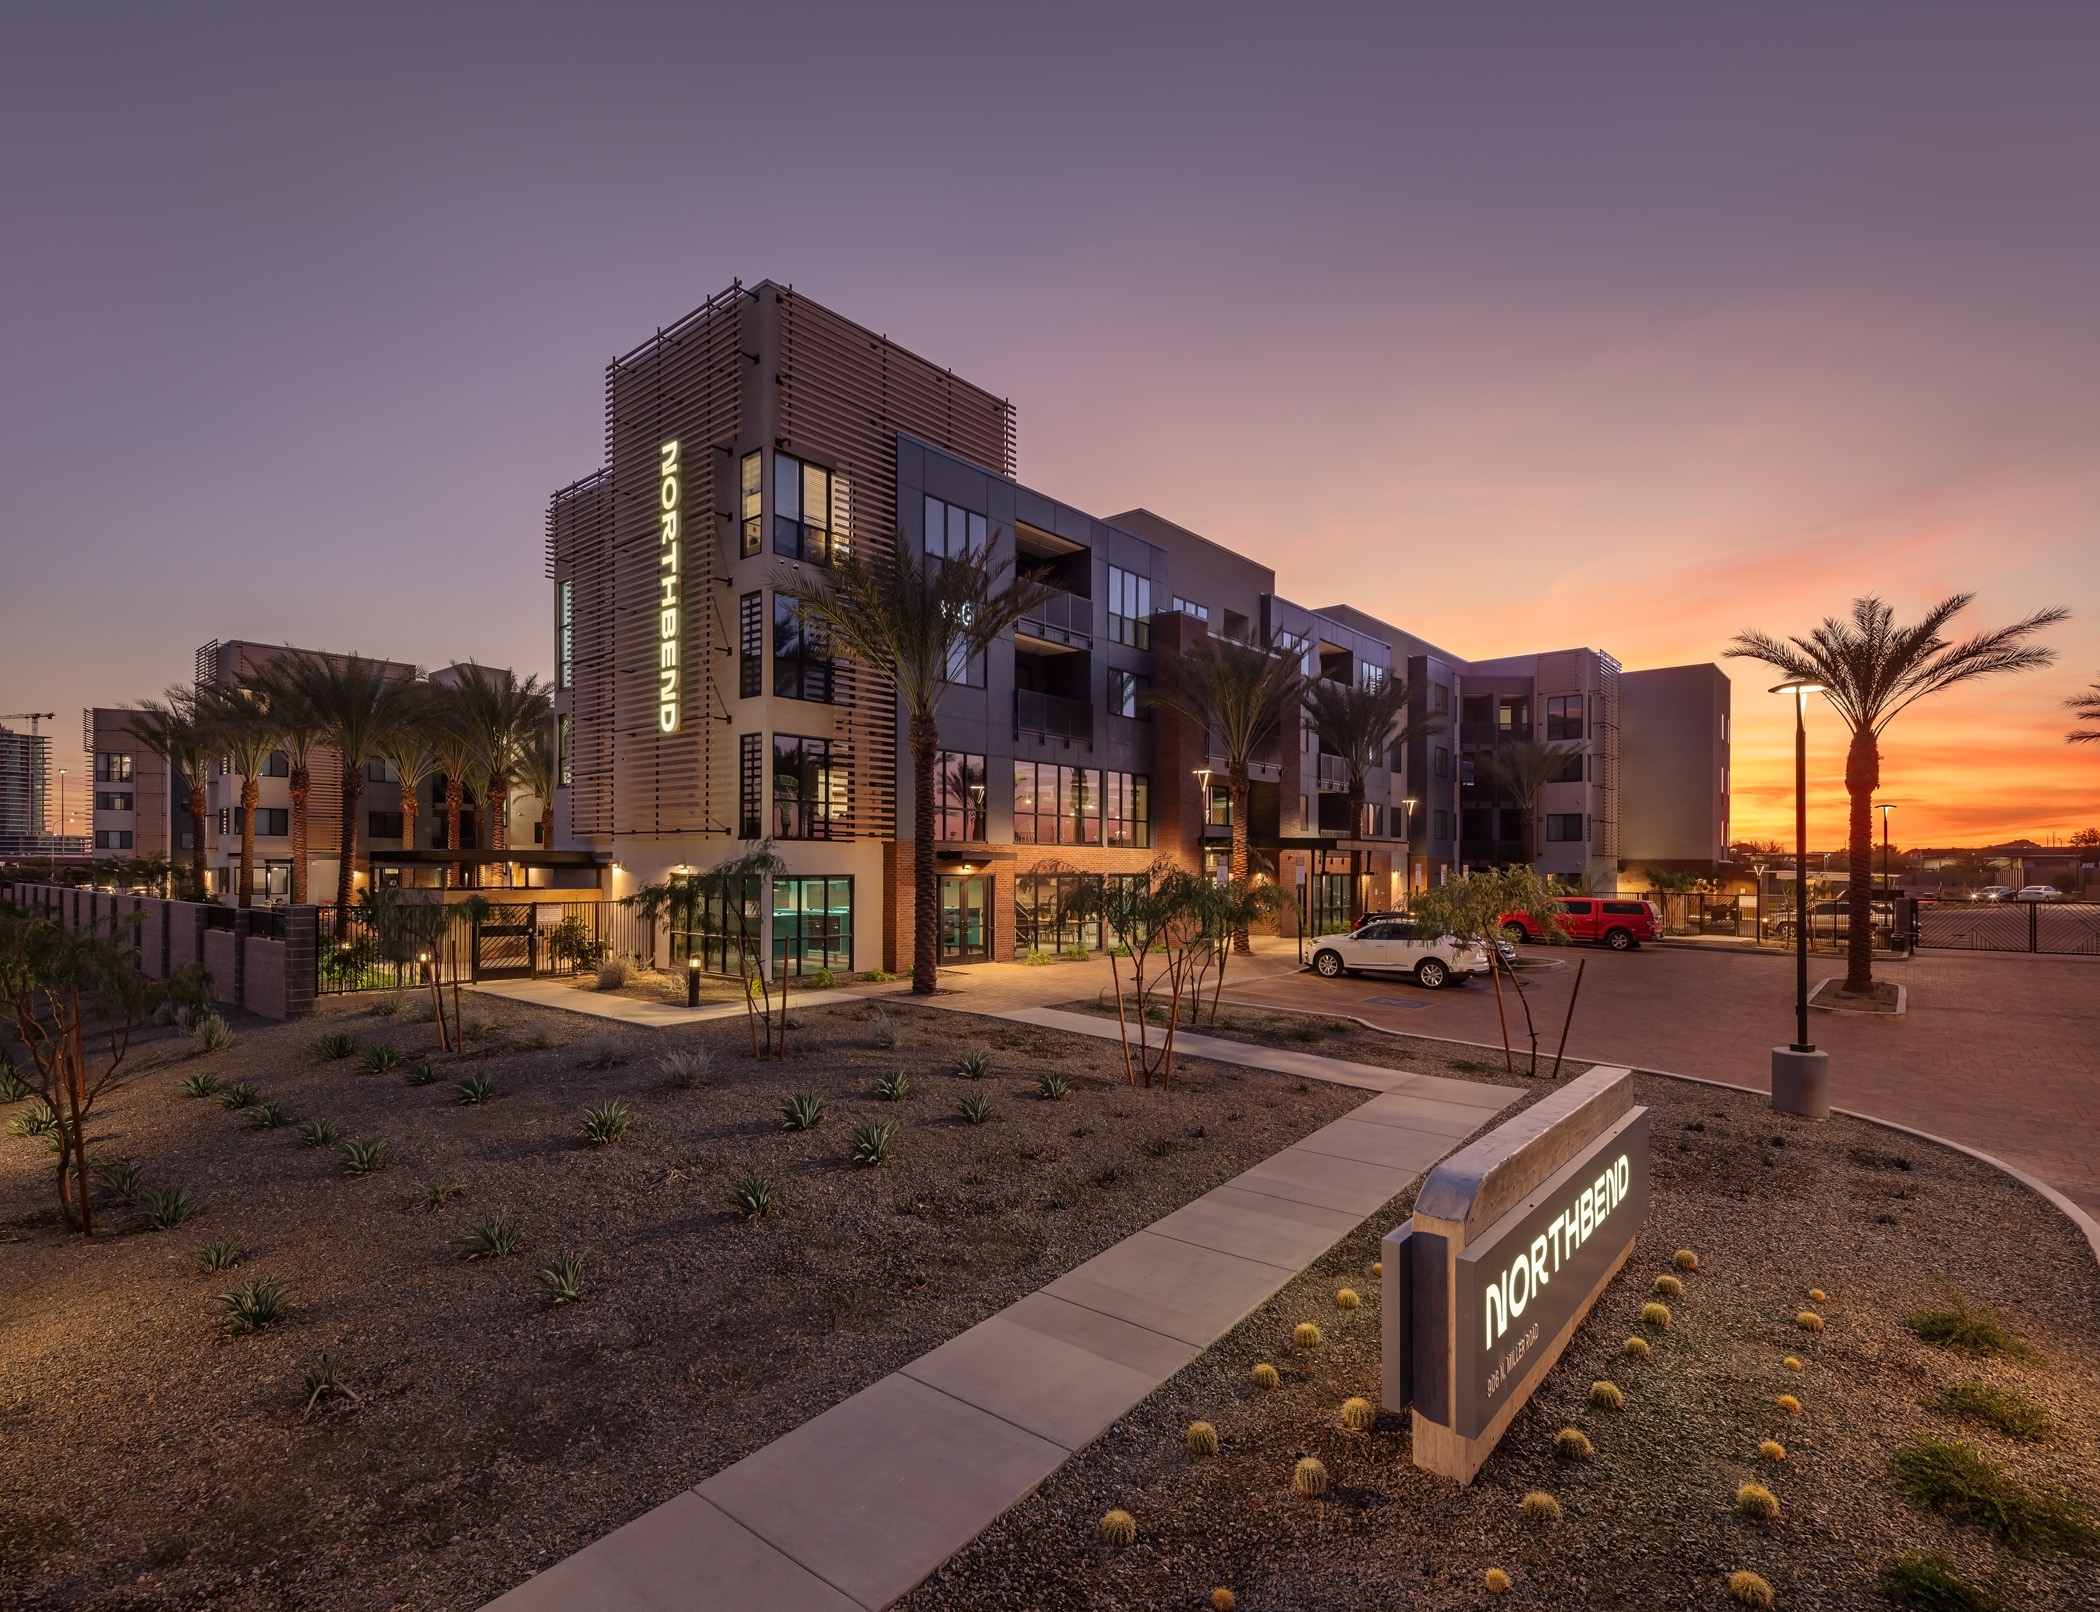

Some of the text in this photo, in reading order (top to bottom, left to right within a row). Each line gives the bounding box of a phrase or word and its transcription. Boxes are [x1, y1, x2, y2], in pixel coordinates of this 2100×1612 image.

[661, 440, 681, 732] NORTHBEND
[1486, 1154, 1629, 1351] NORTHBEND
[1487, 1369, 1500, 1398] 906
[1506, 1339, 1526, 1374] MILLER
[1525, 1322, 1539, 1351] ROAD
